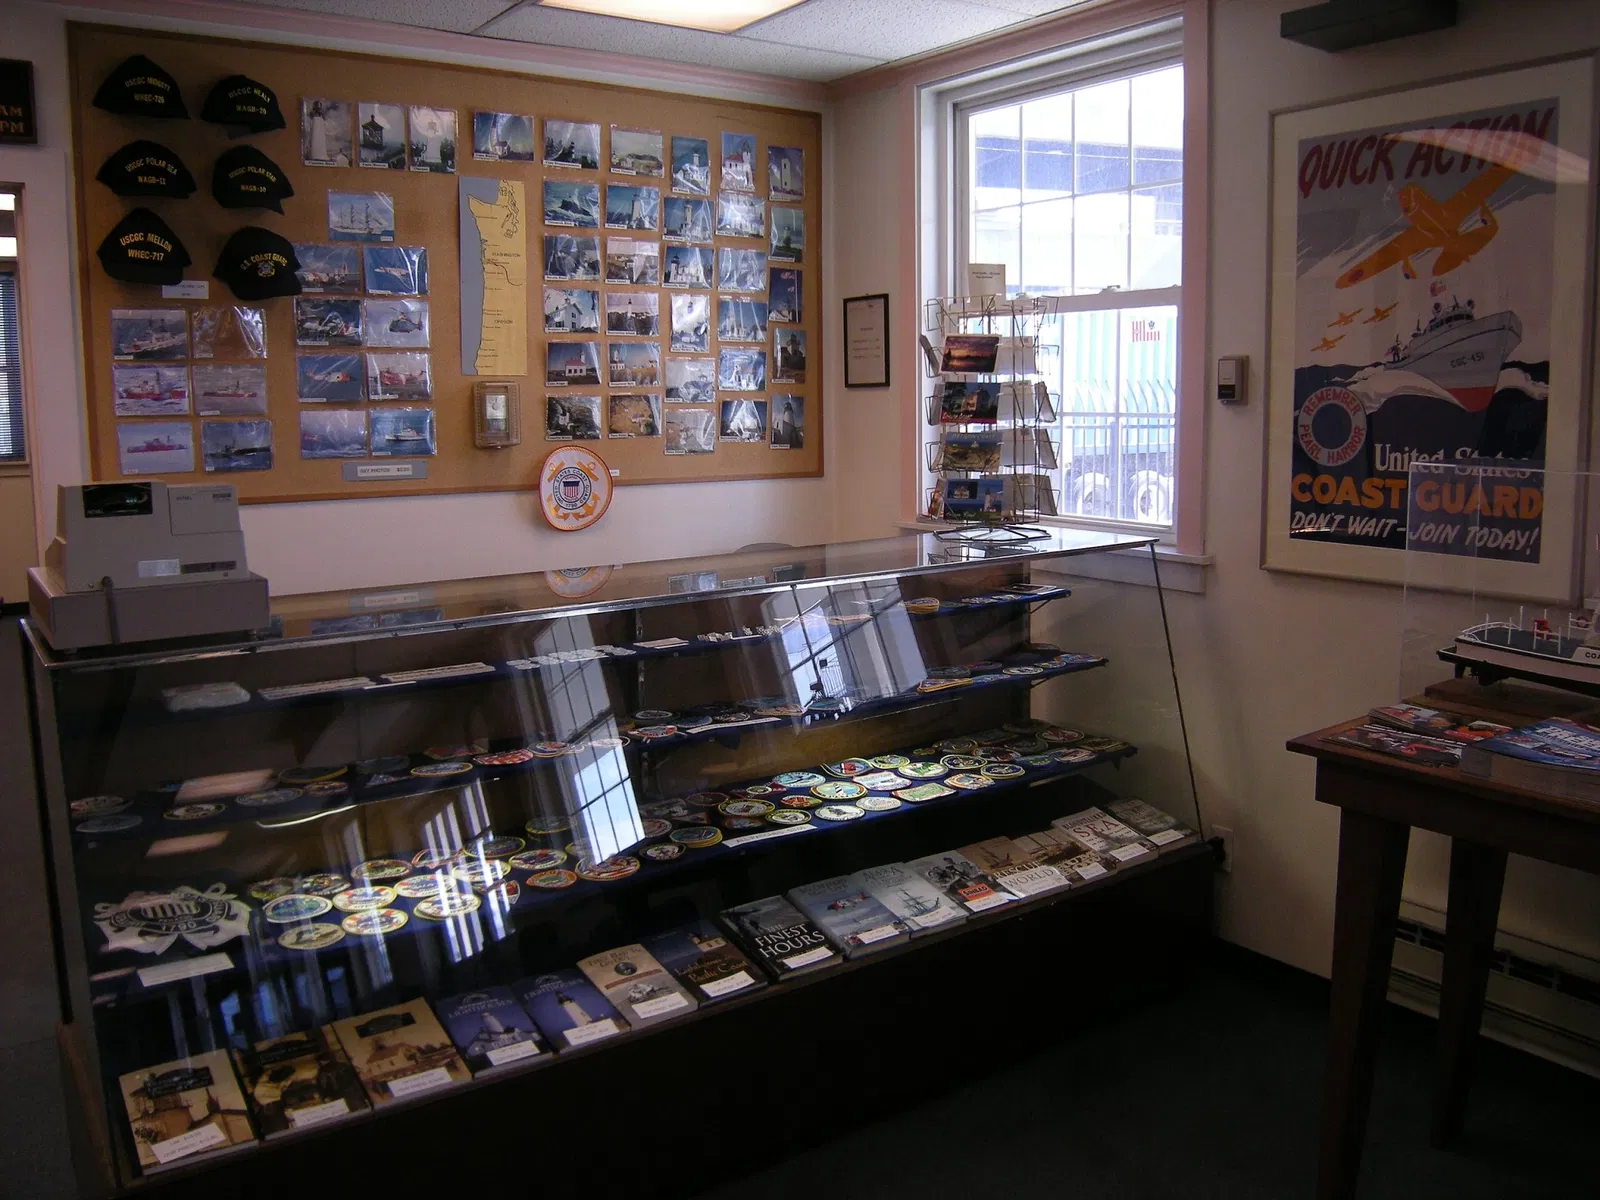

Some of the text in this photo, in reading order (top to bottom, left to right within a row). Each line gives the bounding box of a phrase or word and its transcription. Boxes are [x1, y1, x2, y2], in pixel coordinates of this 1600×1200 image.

[253, 87, 271, 103] HEALY
[1299, 107, 1556, 199] QUICK ACTION
[145, 156, 167, 170] POLAR
[164, 162, 179, 176] SEA
[247, 166, 266, 176] POLAR
[119, 232, 173, 253] USCGC MELLON
[127, 248, 165, 262] WHEC-717
[250, 252, 273, 264] COAST
[271, 252, 289, 267] GUARD
[1302, 388, 1361, 416] REMEMBER
[1300, 424, 1365, 464] PEARL HARBOR
[1374, 443, 1532, 479] United States
[1290, 472, 1544, 521] COAST GUARD
[1291, 510, 1345, 532] DON'T
[1408, 521, 1457, 544] JOIN
[1464, 525, 1540, 556] TODAY!
[1072, 818, 1120, 839] SEA
[1004, 868, 1054, 889] WORLD
[162, 920, 197, 932] 1790
[754, 922, 810, 948] FINEST
[758, 930, 825, 959] HOURS
